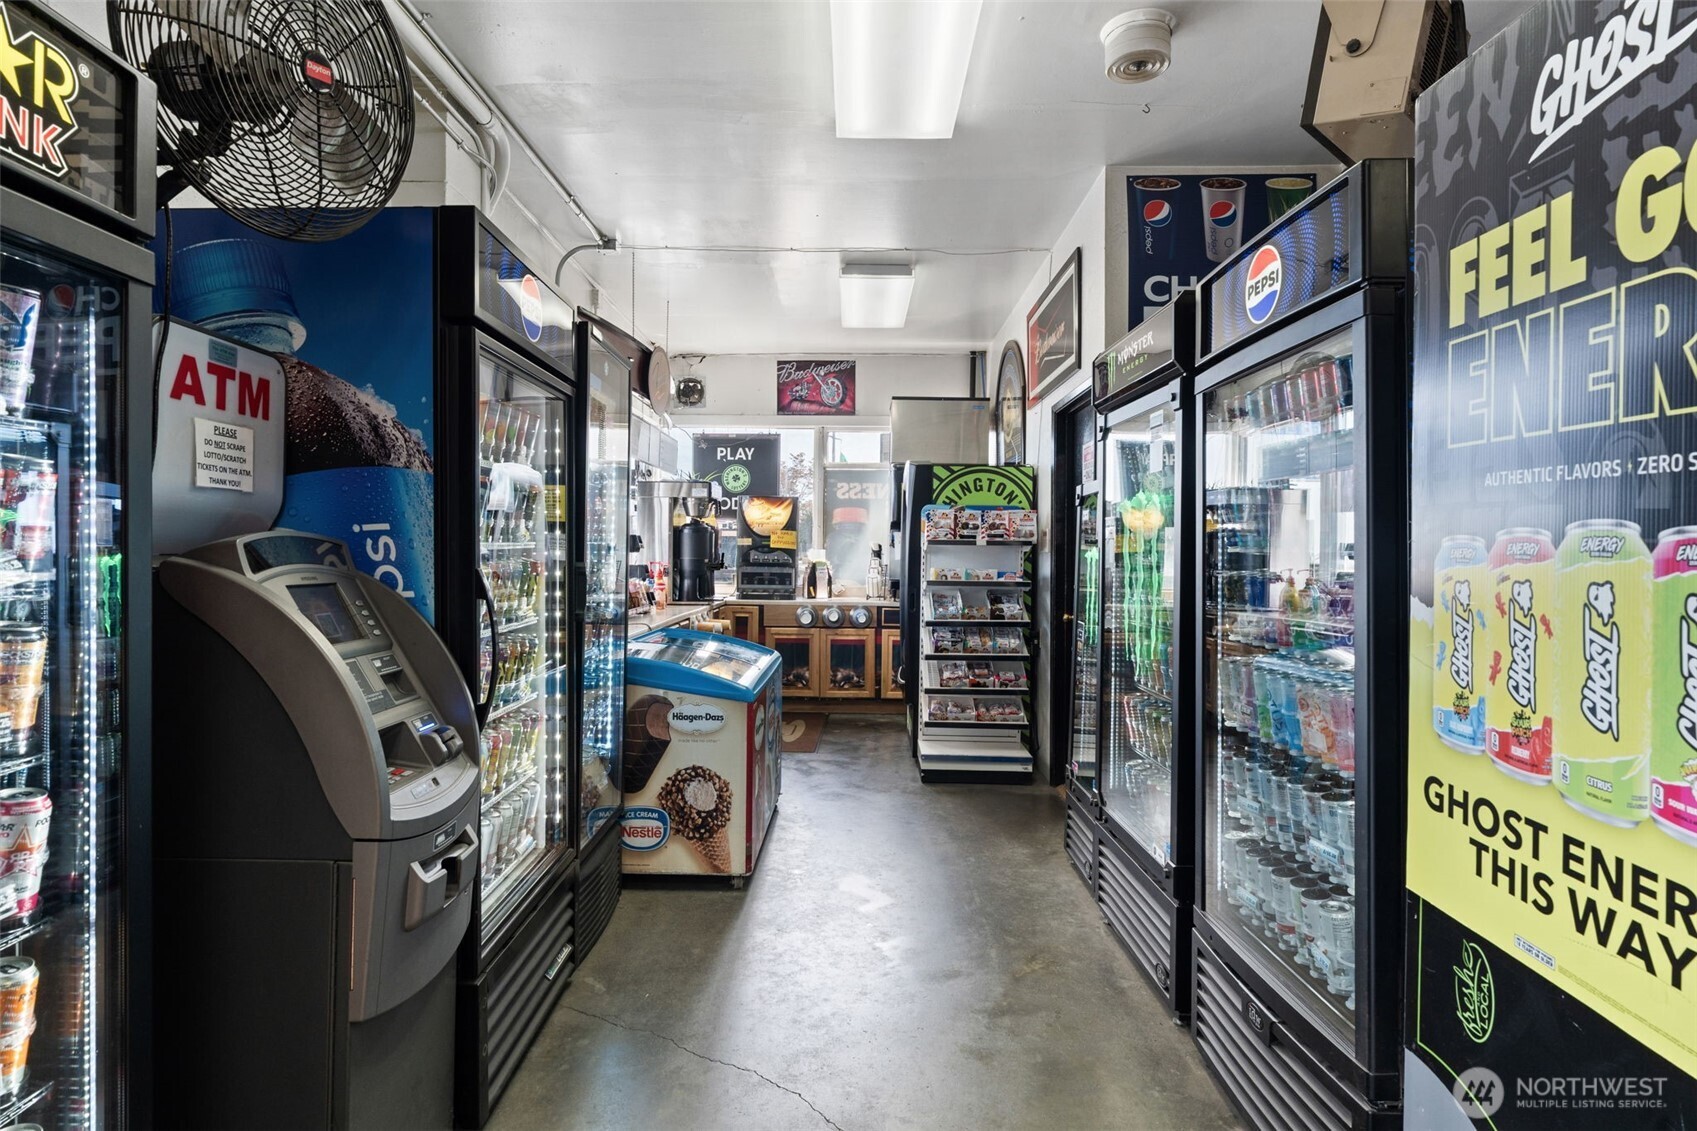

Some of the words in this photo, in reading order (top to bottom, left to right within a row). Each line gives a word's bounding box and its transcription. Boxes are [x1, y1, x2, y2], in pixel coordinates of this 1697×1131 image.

[1449, 191, 1587, 329] FEEL
[1247, 270, 1280, 301] PEPSI
[1117, 331, 1154, 366] MONSTER
[1122, 354, 1149, 374] ENERGY
[169, 353, 270, 422] ATM
[214, 426, 238, 439] PLEASE
[204, 438, 214, 447] DO
[213, 440, 226, 450] NOT
[226, 444, 246, 453] SCRAPE
[717, 447, 755, 461] PLAY
[203, 451, 247, 465] LOTTO/SCRATCH
[197, 462, 218, 473] TICKETS
[219, 465, 228, 474] ON
[228, 467, 238, 475] THE
[1484, 466, 1553, 487] AUTHENTIC
[1556, 459, 1622, 482] FLAVORS
[1637, 453, 1684, 475] ZERO
[208, 477, 228, 486] THANK
[1450, 548, 1476, 559] ENERGY
[1506, 542, 1541, 557] ENERGY
[1580, 536, 1625, 554] ENERGY
[1450, 596, 1475, 695] GHOST
[1507, 598, 1538, 714] GHOST
[1581, 603, 1621, 742] GHOST
[672, 712, 725, 724] Häagen-Dazs
[1586, 776, 1613, 793] CITRUS
[1423, 775, 1549, 862] GHOST
[1468, 836, 1554, 916] THIS
[1567, 886, 1697, 992] WAY
[1480, 972, 1490, 1030] LOCAL
